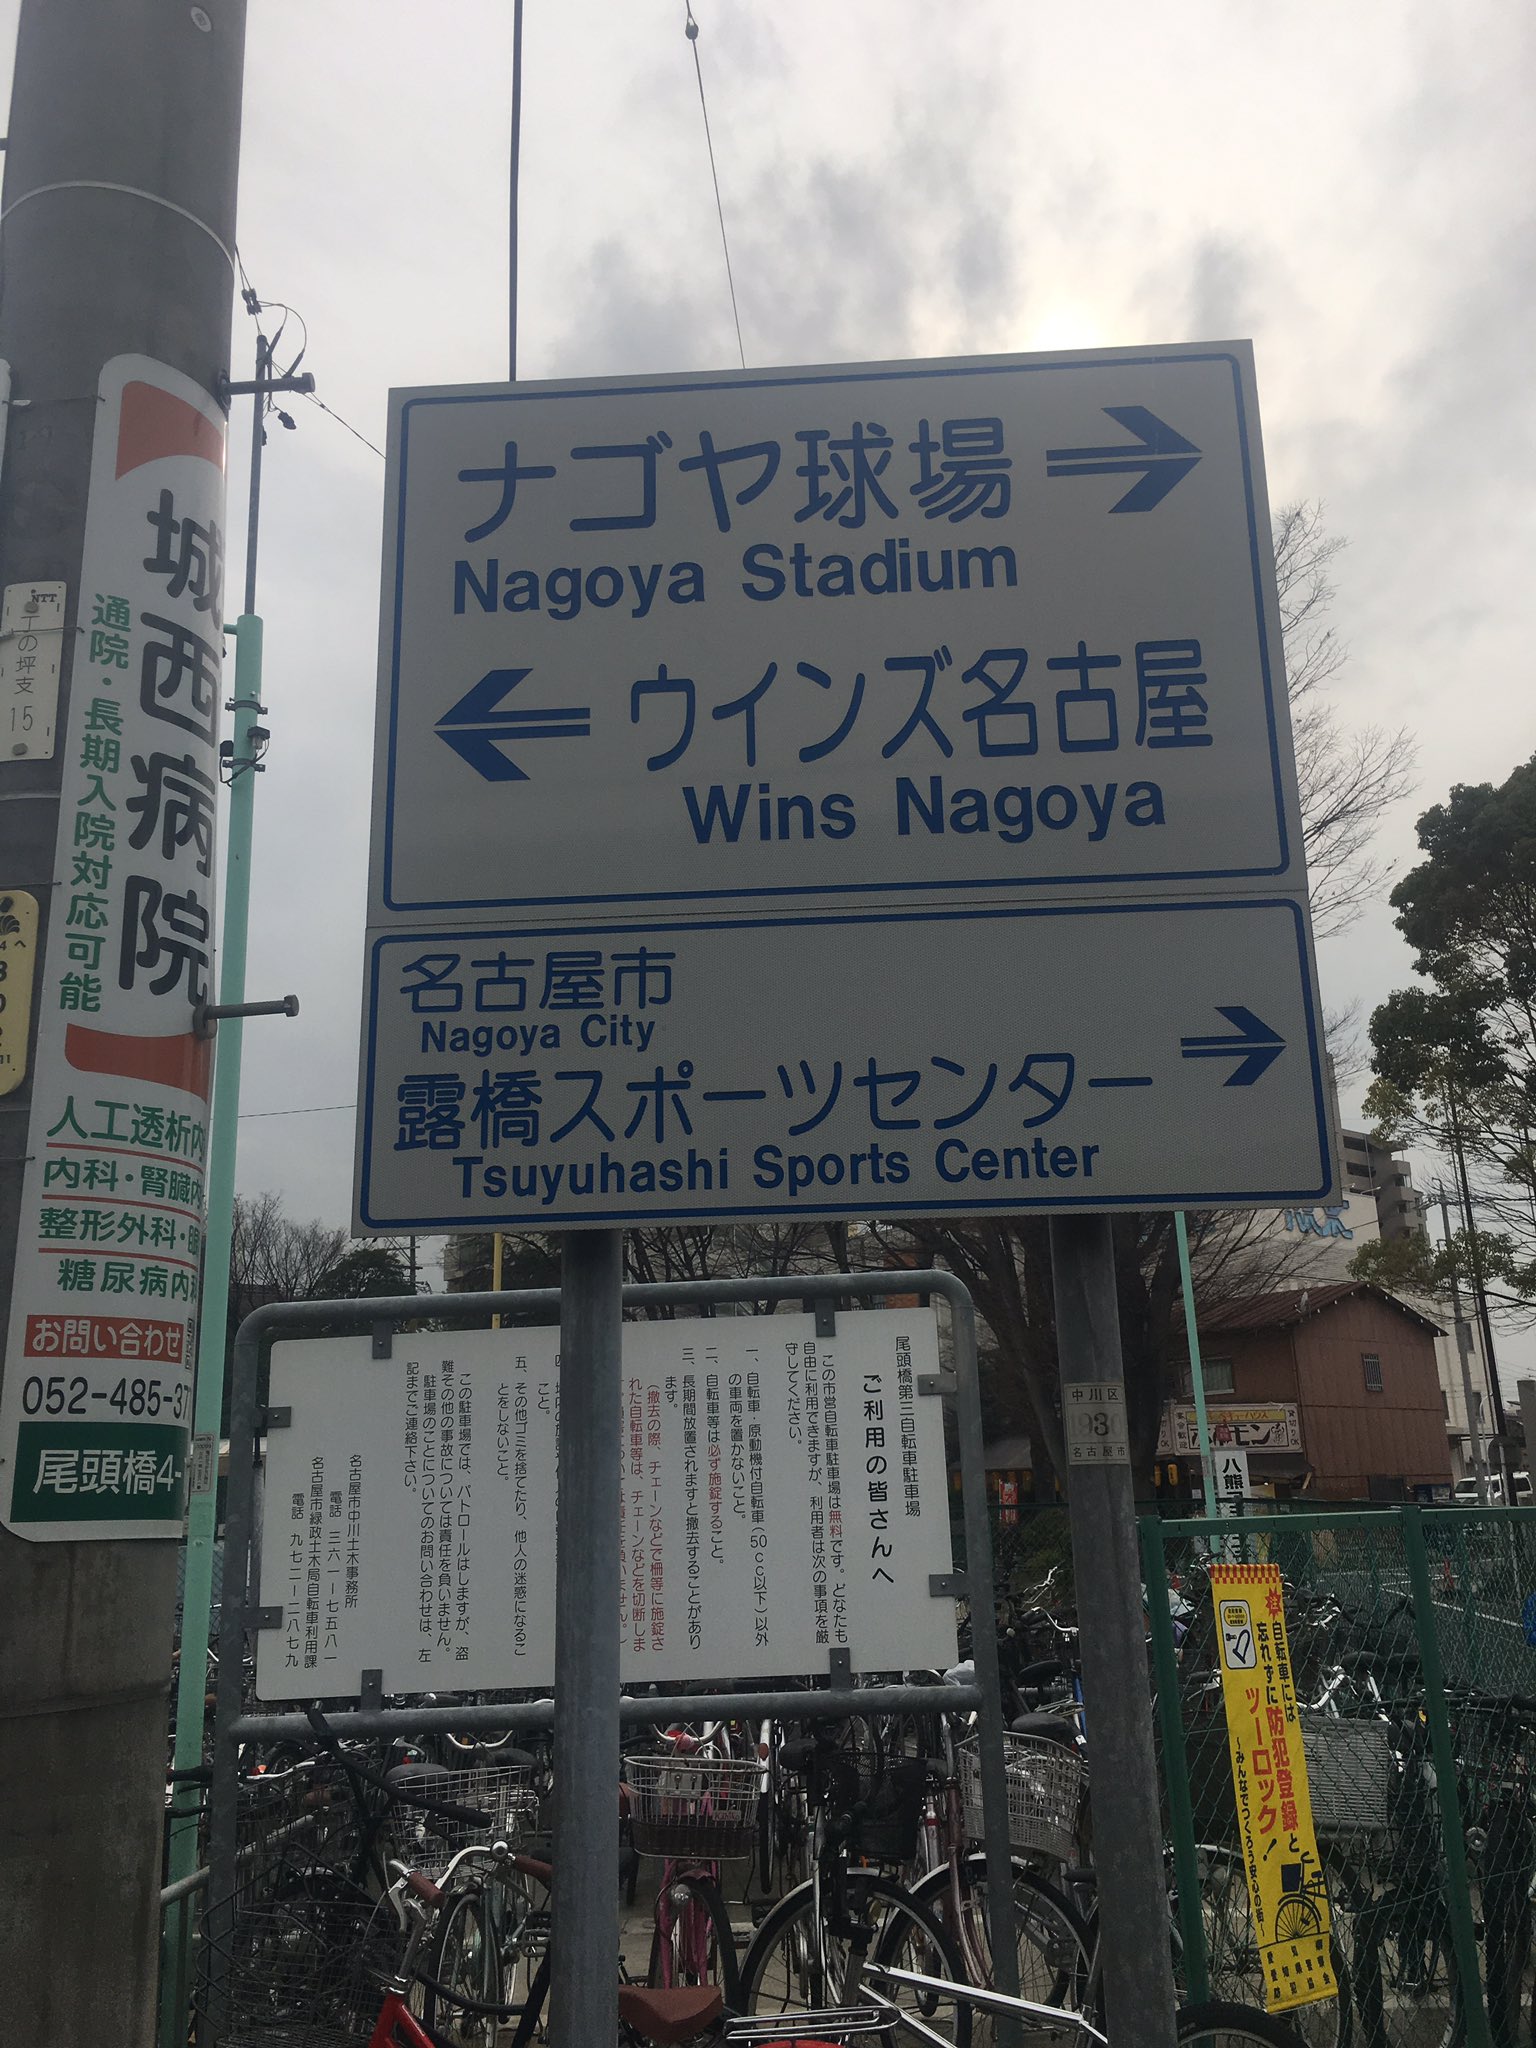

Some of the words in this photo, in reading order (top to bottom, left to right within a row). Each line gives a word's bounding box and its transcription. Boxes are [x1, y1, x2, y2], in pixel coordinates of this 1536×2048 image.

[457, 416, 1012, 543] ナゴヤ球場
[31, 593, 57, 603] NTT
[453, 558, 706, 620] Nagoya
[741, 538, 1018, 601] Stadium
[10, 705, 33, 731] 15
[118, 488, 226, 1007] 城西病院
[629, 638, 1213, 772] ウインズ名古屋
[59, 593, 131, 1013] 通院・長期入院対応可能
[682, 780, 855, 845] Wins
[895, 775, 1166, 843] Nagoya
[400, 946, 676, 1014] 名古屋市
[420, 1018, 561, 1057] Nagoya
[580, 1011, 656, 1052] City
[394, 1052, 1153, 1153] 露橋スポーツセンター
[452, 1146, 729, 1206] Tsuyuhashi
[752, 1144, 911, 1198] Sports
[934, 1136, 1100, 1184] Center
[31, 1317, 182, 1360] お問い合わせ
[403, 1362, 419, 1494] 記までご連絡下さい。
[496, 1382, 510, 1481] とをしないこと。
[537, 1382, 551, 1415] こと。
[664, 1375, 679, 1409] ます。
[785, 1342, 802, 1445] 守してください。
[895, 1336, 921, 1517] 尾頭橋第三自転車駐車場
[1072, 1388, 1119, 1402] 中川区
[705, 1346, 724, 1565] 二、自転車等は必ず施錠すること。
[728, 1373, 746, 1520] の車両を置かないこと。
[863, 1374, 894, 1583] ご利用の皆さんへ
[1073, 1445, 1126, 1459] 名古屋市
[291, 1493, 305, 1520] 電話
[329, 1491, 343, 1518] 電話
[344, 1454, 362, 1608] 名古屋市中川土木事務所
[628, 1377, 646, 1652] れた自転車等は、チェーンなどを切断しま
[682, 1346, 702, 1650] 三、長期間放置されますと撤去することがあり
[304, 1456, 324, 1669] 名古屋市緑政土木局自転車利用課
[1272, 1621, 1296, 1724] 自転車には
[1256, 1621, 1300, 1854] 忘れずに防犯登録と
